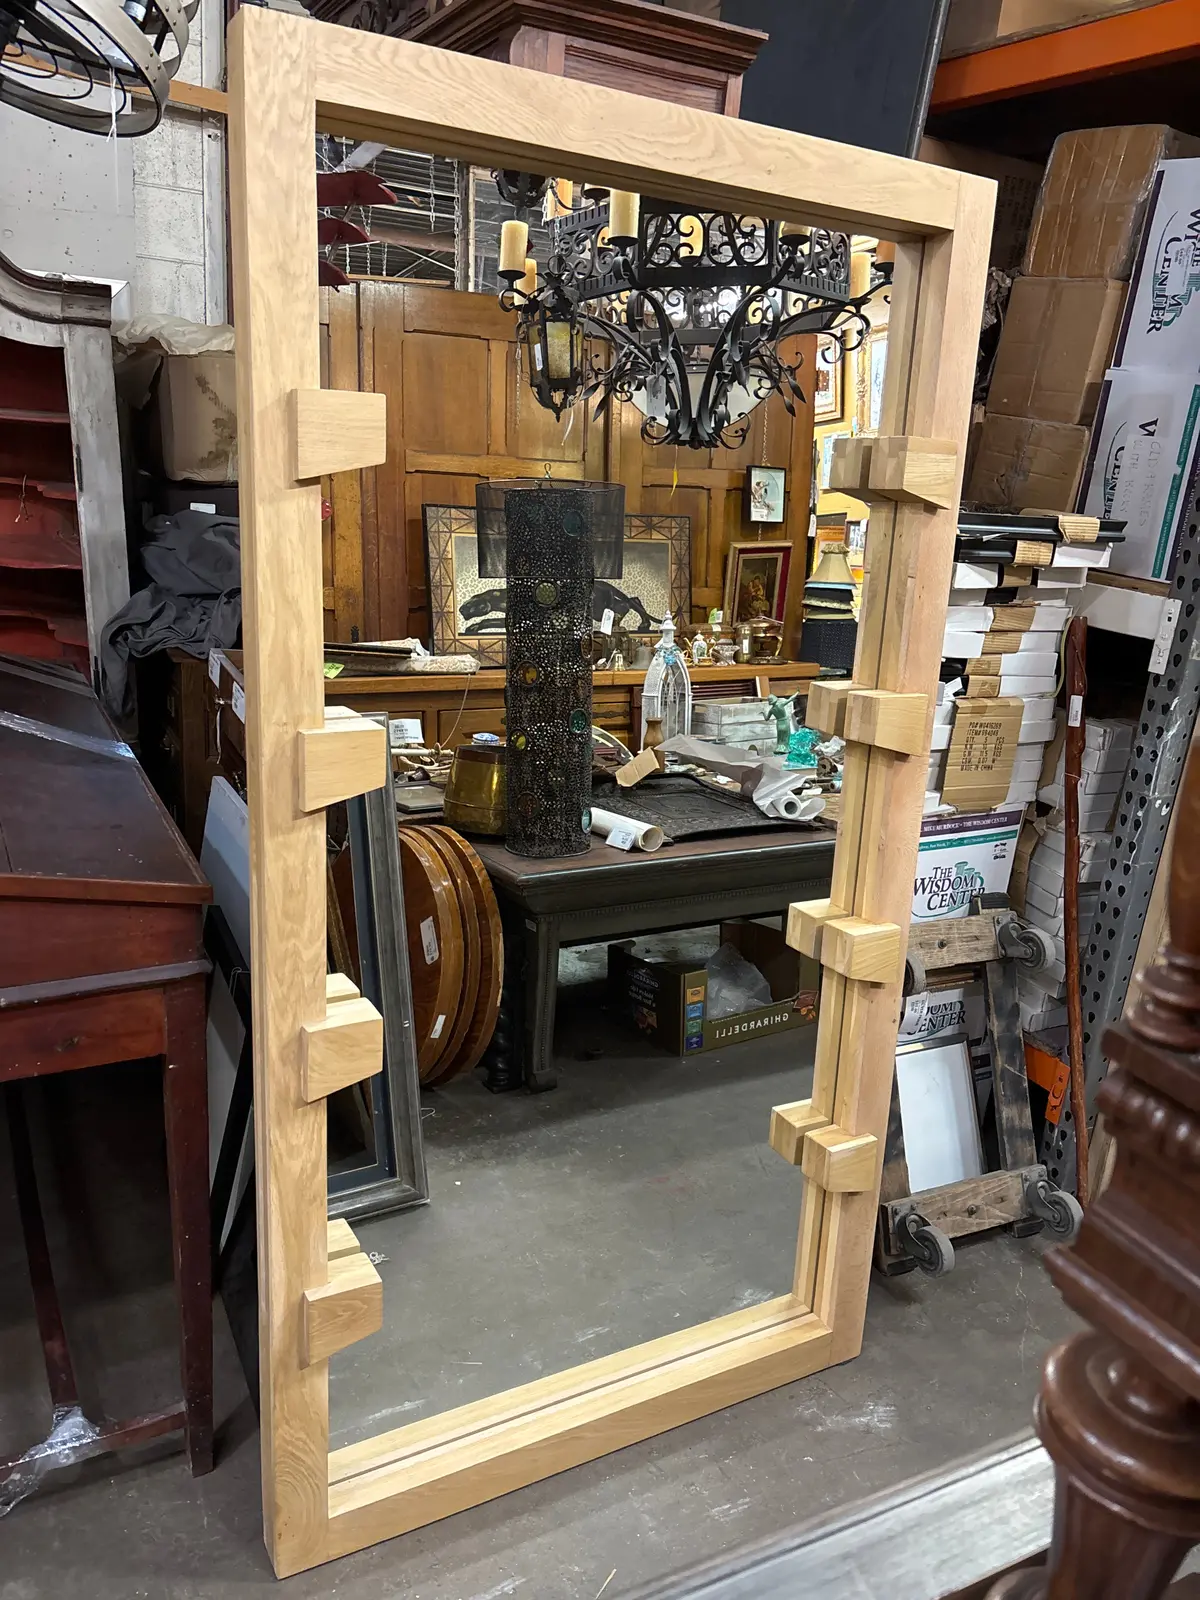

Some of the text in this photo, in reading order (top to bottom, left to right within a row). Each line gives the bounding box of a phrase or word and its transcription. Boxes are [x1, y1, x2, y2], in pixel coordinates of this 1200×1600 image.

[914, 873, 975, 897] WISDOM
[933, 866, 953, 880] THE
[907, 1010, 966, 1036] ENTER
